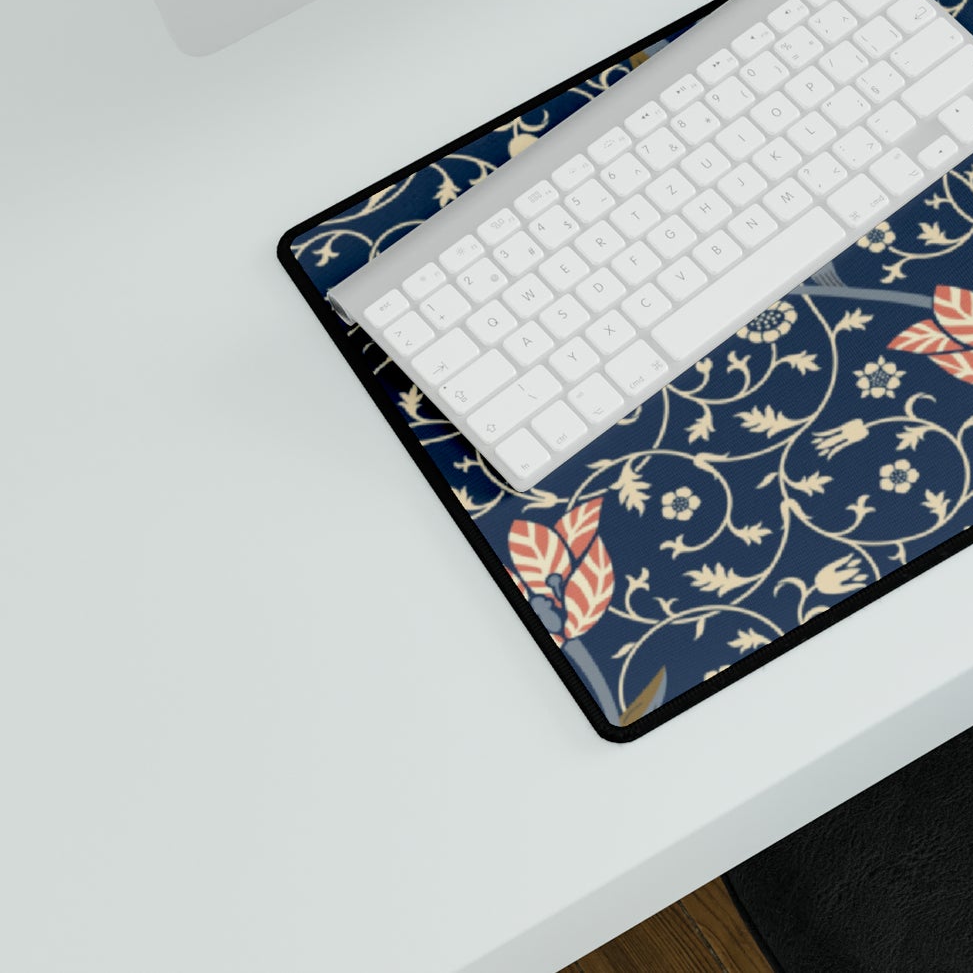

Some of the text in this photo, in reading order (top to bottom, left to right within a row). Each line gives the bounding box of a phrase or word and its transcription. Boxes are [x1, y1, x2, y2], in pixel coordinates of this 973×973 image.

[521, 289, 536, 302] W
[560, 264, 571, 274] E
[595, 238, 607, 248] R
[631, 211, 641, 220] T
[666, 185, 678, 196] Z
[700, 158, 713, 170] U
[771, 108, 783, 118] O
[805, 83, 814, 92] P
[522, 127, 816, 348] A S D F G H J K L
[568, 351, 577, 362] Y
[604, 325, 617, 337] X
[641, 298, 652, 308] C
[675, 271, 686, 281] V
[711, 246, 723, 256] B
[746, 218, 759, 230] N
[781, 192, 795, 204] M
